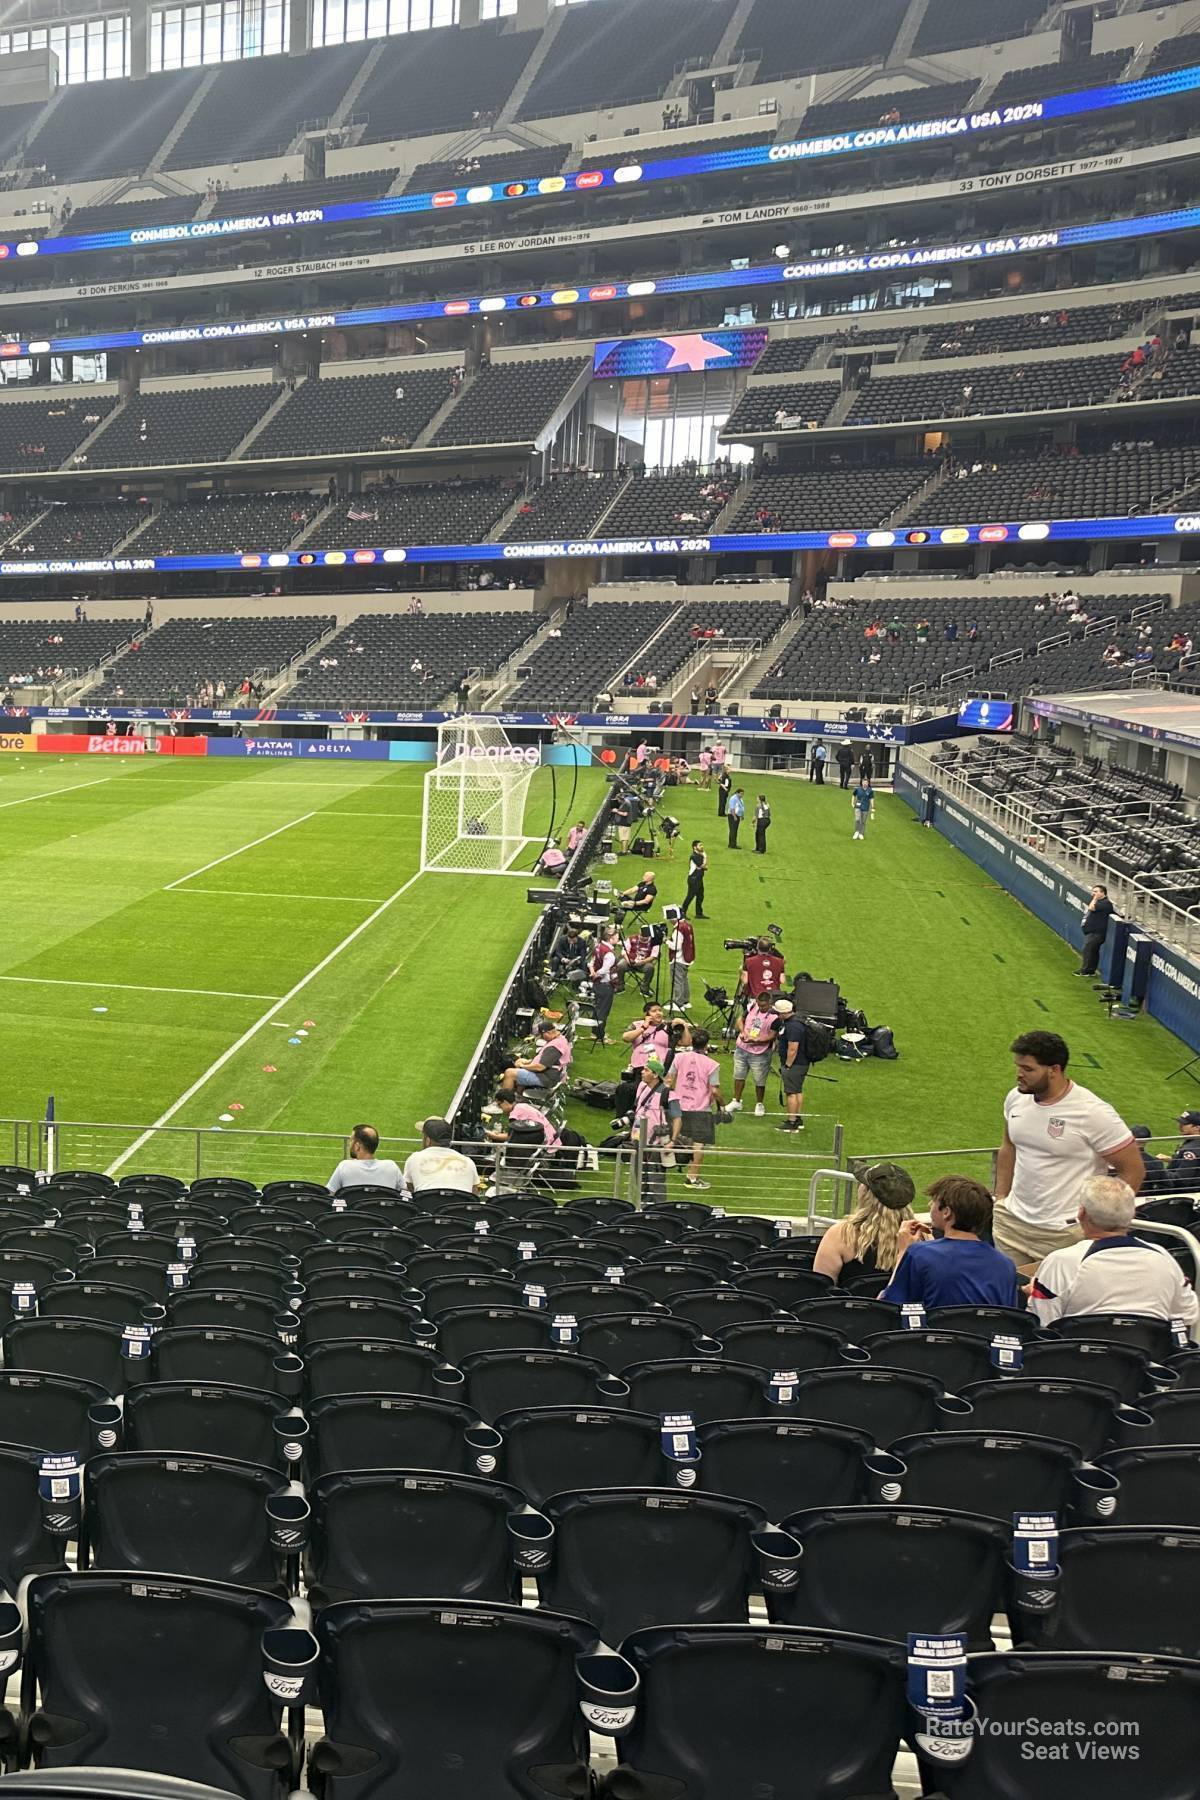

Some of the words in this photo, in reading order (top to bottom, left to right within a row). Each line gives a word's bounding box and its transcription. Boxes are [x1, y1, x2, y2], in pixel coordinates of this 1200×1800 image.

[769, 136, 853, 160] CONMEBOL
[854, 130, 897, 146] COPA
[897, 116, 967, 140] AMERICA
[970, 111, 1001, 127] USA
[1003, 103, 1042, 122] 2024
[959, 181, 974, 191] 33
[979, 174, 1012, 188] TONY
[1015, 163, 1076, 183] DORSETT
[718, 213, 742, 223] TOM
[745, 207, 790, 220] LANDRY
[131, 225, 191, 242] CONMEBOL
[190, 221, 221, 237] COPA
[219, 216, 271, 234] AMERICA
[273, 213, 295, 228] USA
[296, 210, 324, 224] 2024
[464, 245, 475, 253] 55
[479, 242, 496, 252] LEE
[498, 240, 516, 250] ROY
[517, 236, 555, 248] JORDAN
[783, 259, 867, 279] CONMEBOL
[868, 253, 911, 269] COPA
[909, 246, 982, 264] AMERICA
[985, 241, 1016, 254] USA
[1018, 234, 1058, 249] 2024
[266, 266, 294, 276] ROGER
[295, 261, 337, 273] STAUBACH
[77, 288, 87, 296] 43
[90, 285, 106, 295] DON
[108, 283, 140, 293] PERKINS
[142, 328, 202, 344] CONMEBOL
[202, 324, 234, 340] COPA
[231, 320, 282, 336] AMERICA
[284, 318, 306, 332] USA
[307, 316, 335, 329] 2024
[503, 543, 567, 557] CONMEBOL
[567, 542, 600, 556] COPA
[597, 540, 653, 555] AMERICA
[655, 539, 679, 552] USA
[680, 538, 710, 552] 2024
[257, 741, 293, 749] LATAM
[319, 745, 352, 753] DELTA
[589, 1708, 627, 1725] Ford
